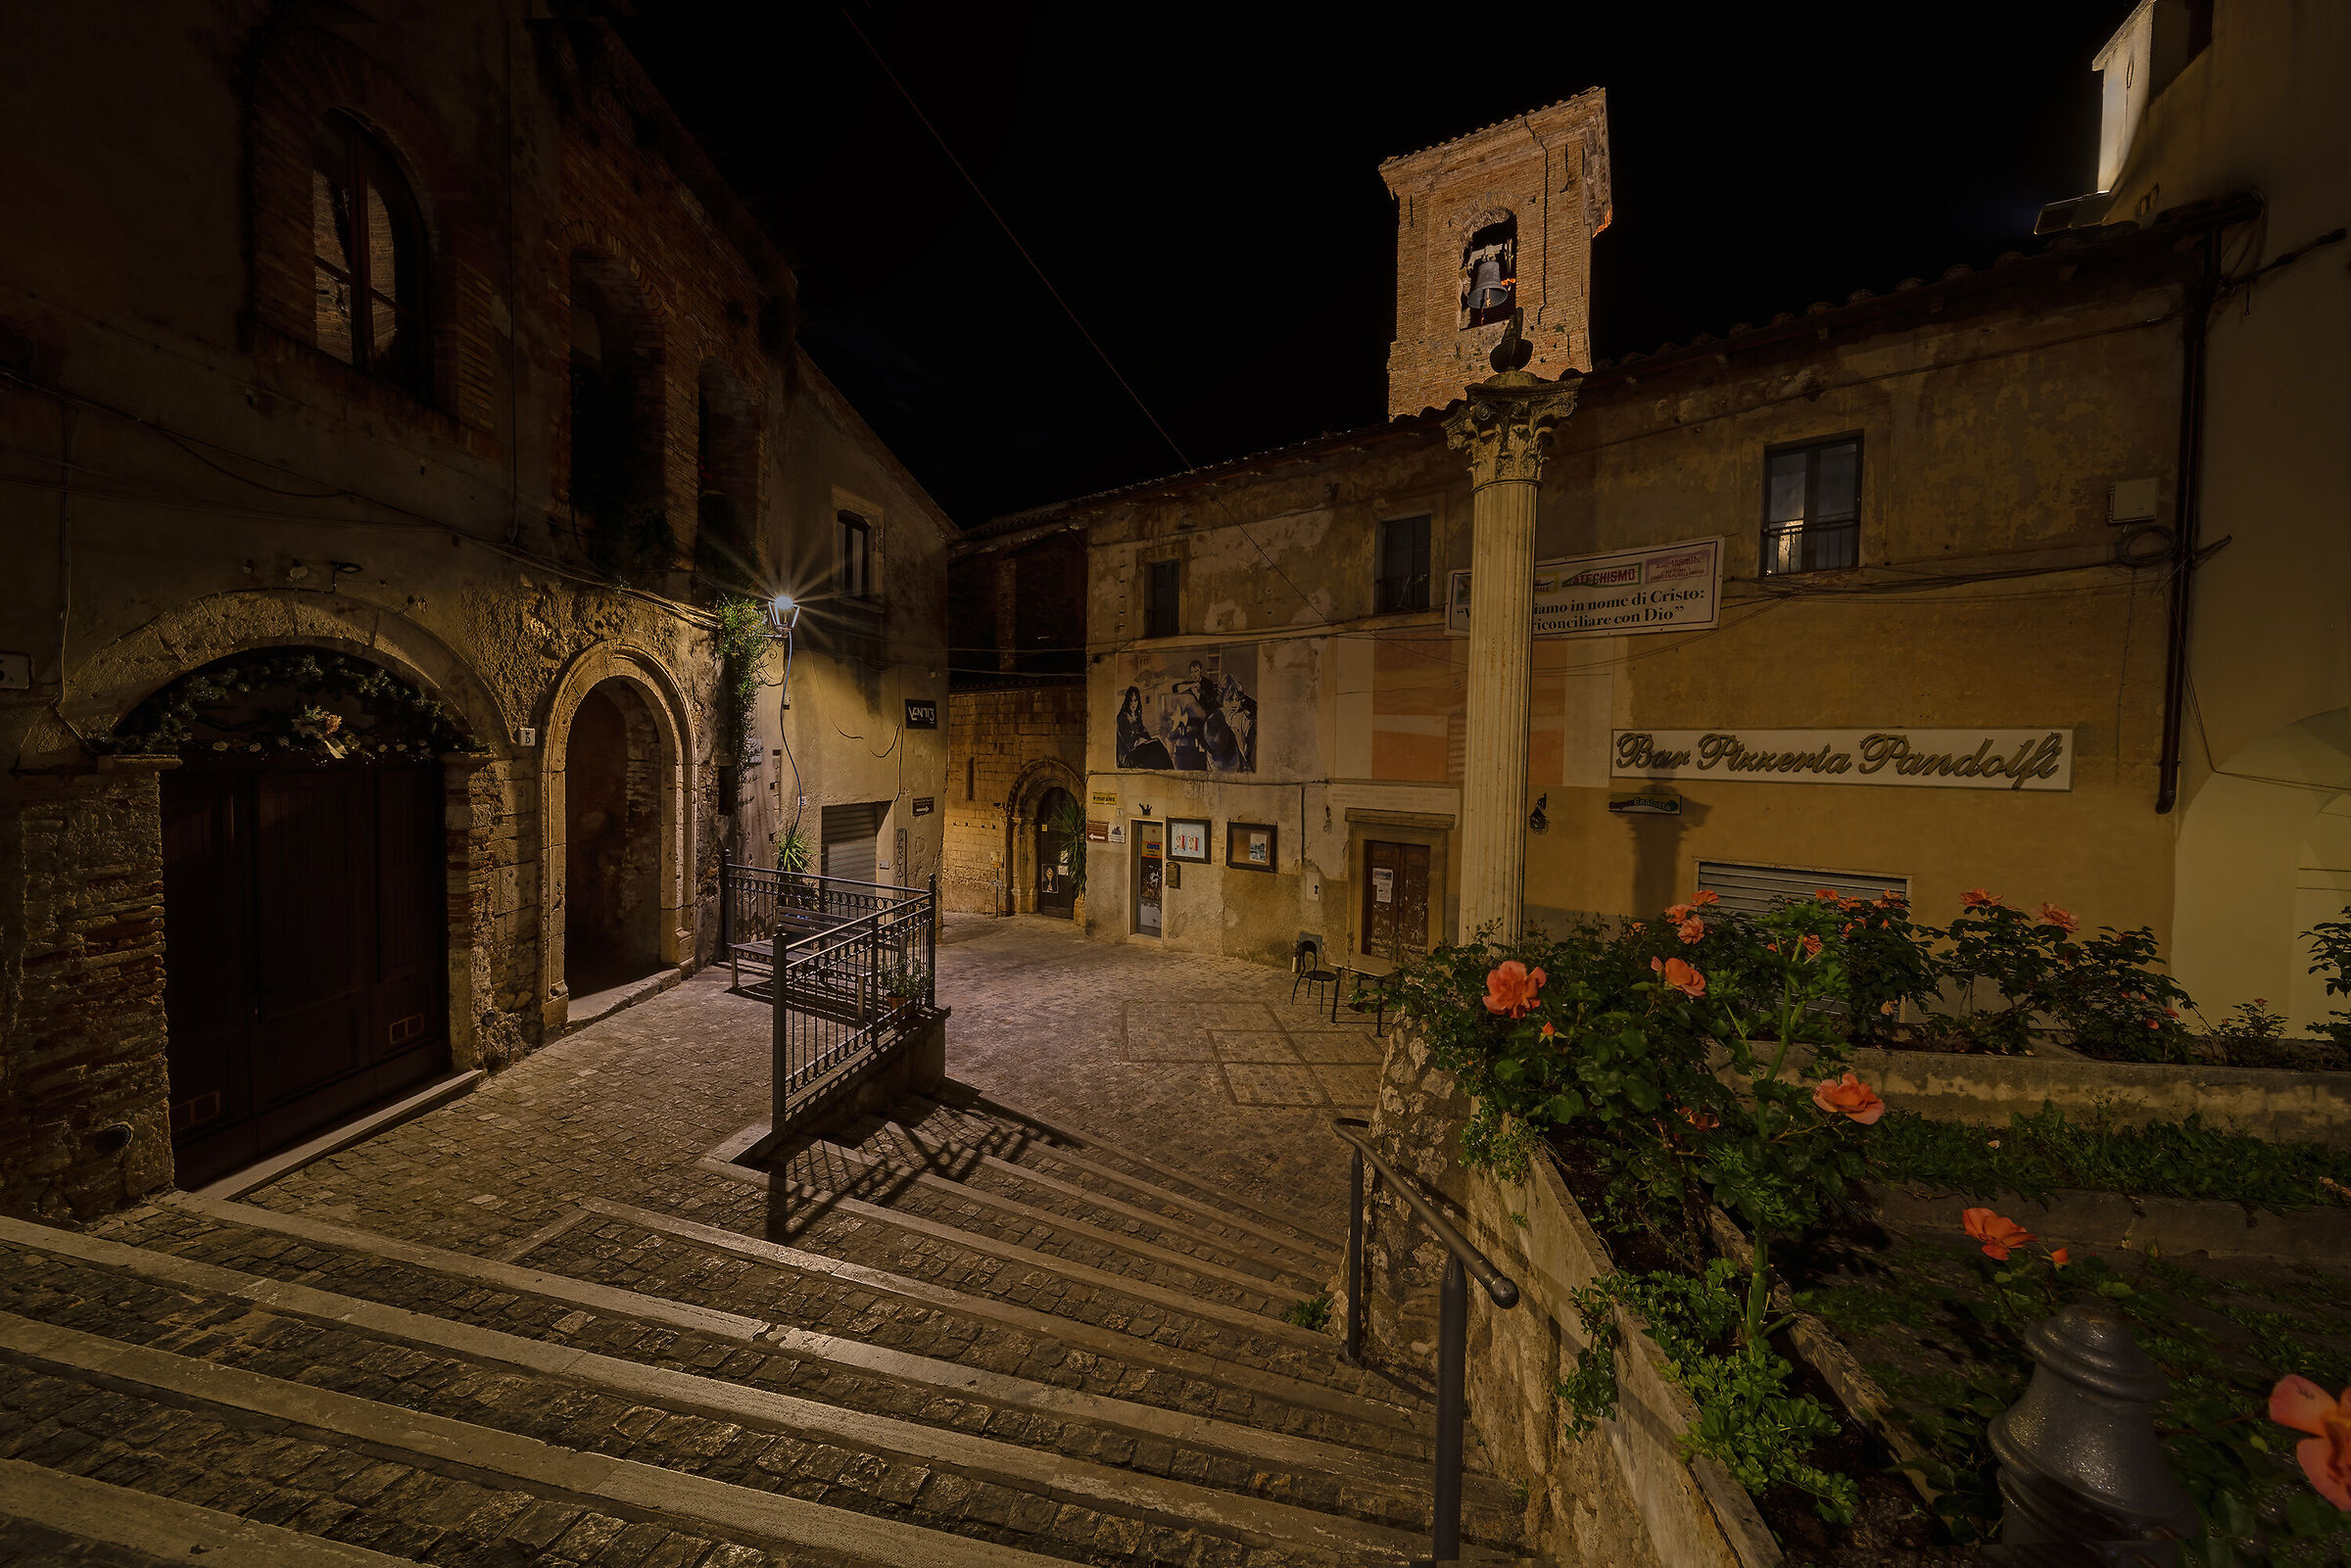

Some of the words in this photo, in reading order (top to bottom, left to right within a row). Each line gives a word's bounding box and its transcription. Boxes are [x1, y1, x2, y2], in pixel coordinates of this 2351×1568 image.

[1570, 599, 1584, 612] in
[1588, 597, 1628, 610] nome
[1631, 592, 1647, 606] di
[1650, 588, 1704, 603] Cristo:
[1613, 613, 1640, 625] con
[1616, 733, 1691, 769] Bar
[1697, 734, 1852, 775] Pizzeria
[1858, 733, 2063, 791] Pandolfi
